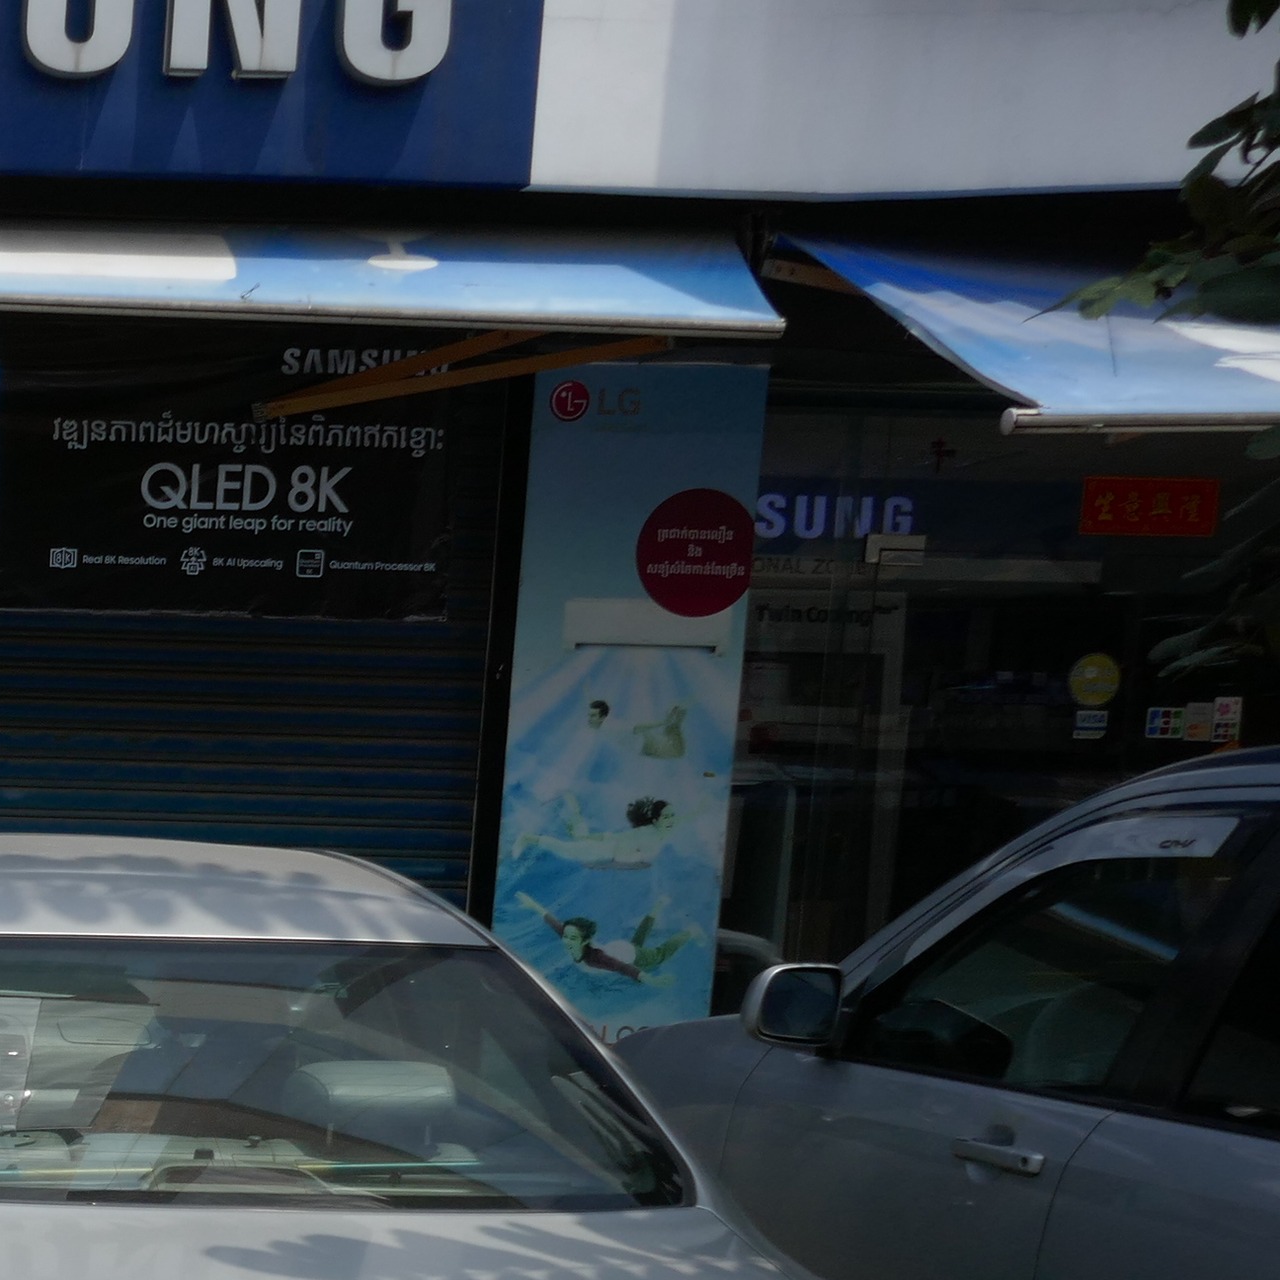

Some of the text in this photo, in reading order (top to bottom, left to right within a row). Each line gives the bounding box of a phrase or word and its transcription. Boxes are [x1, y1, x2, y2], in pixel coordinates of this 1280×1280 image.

[280, 347, 450, 377] SAMS
[597, 387, 641, 416] LG
[140, 462, 354, 514] QLED 8K
[142, 514, 354, 536] One giant leap for reality
[82, 554, 168, 566] Real 8K Resolution
[212, 557, 225, 567] 8K
[237, 557, 284, 571] Upscaling
[329, 560, 374, 571] Quantum
[374, 561, 423, 572] Processor
